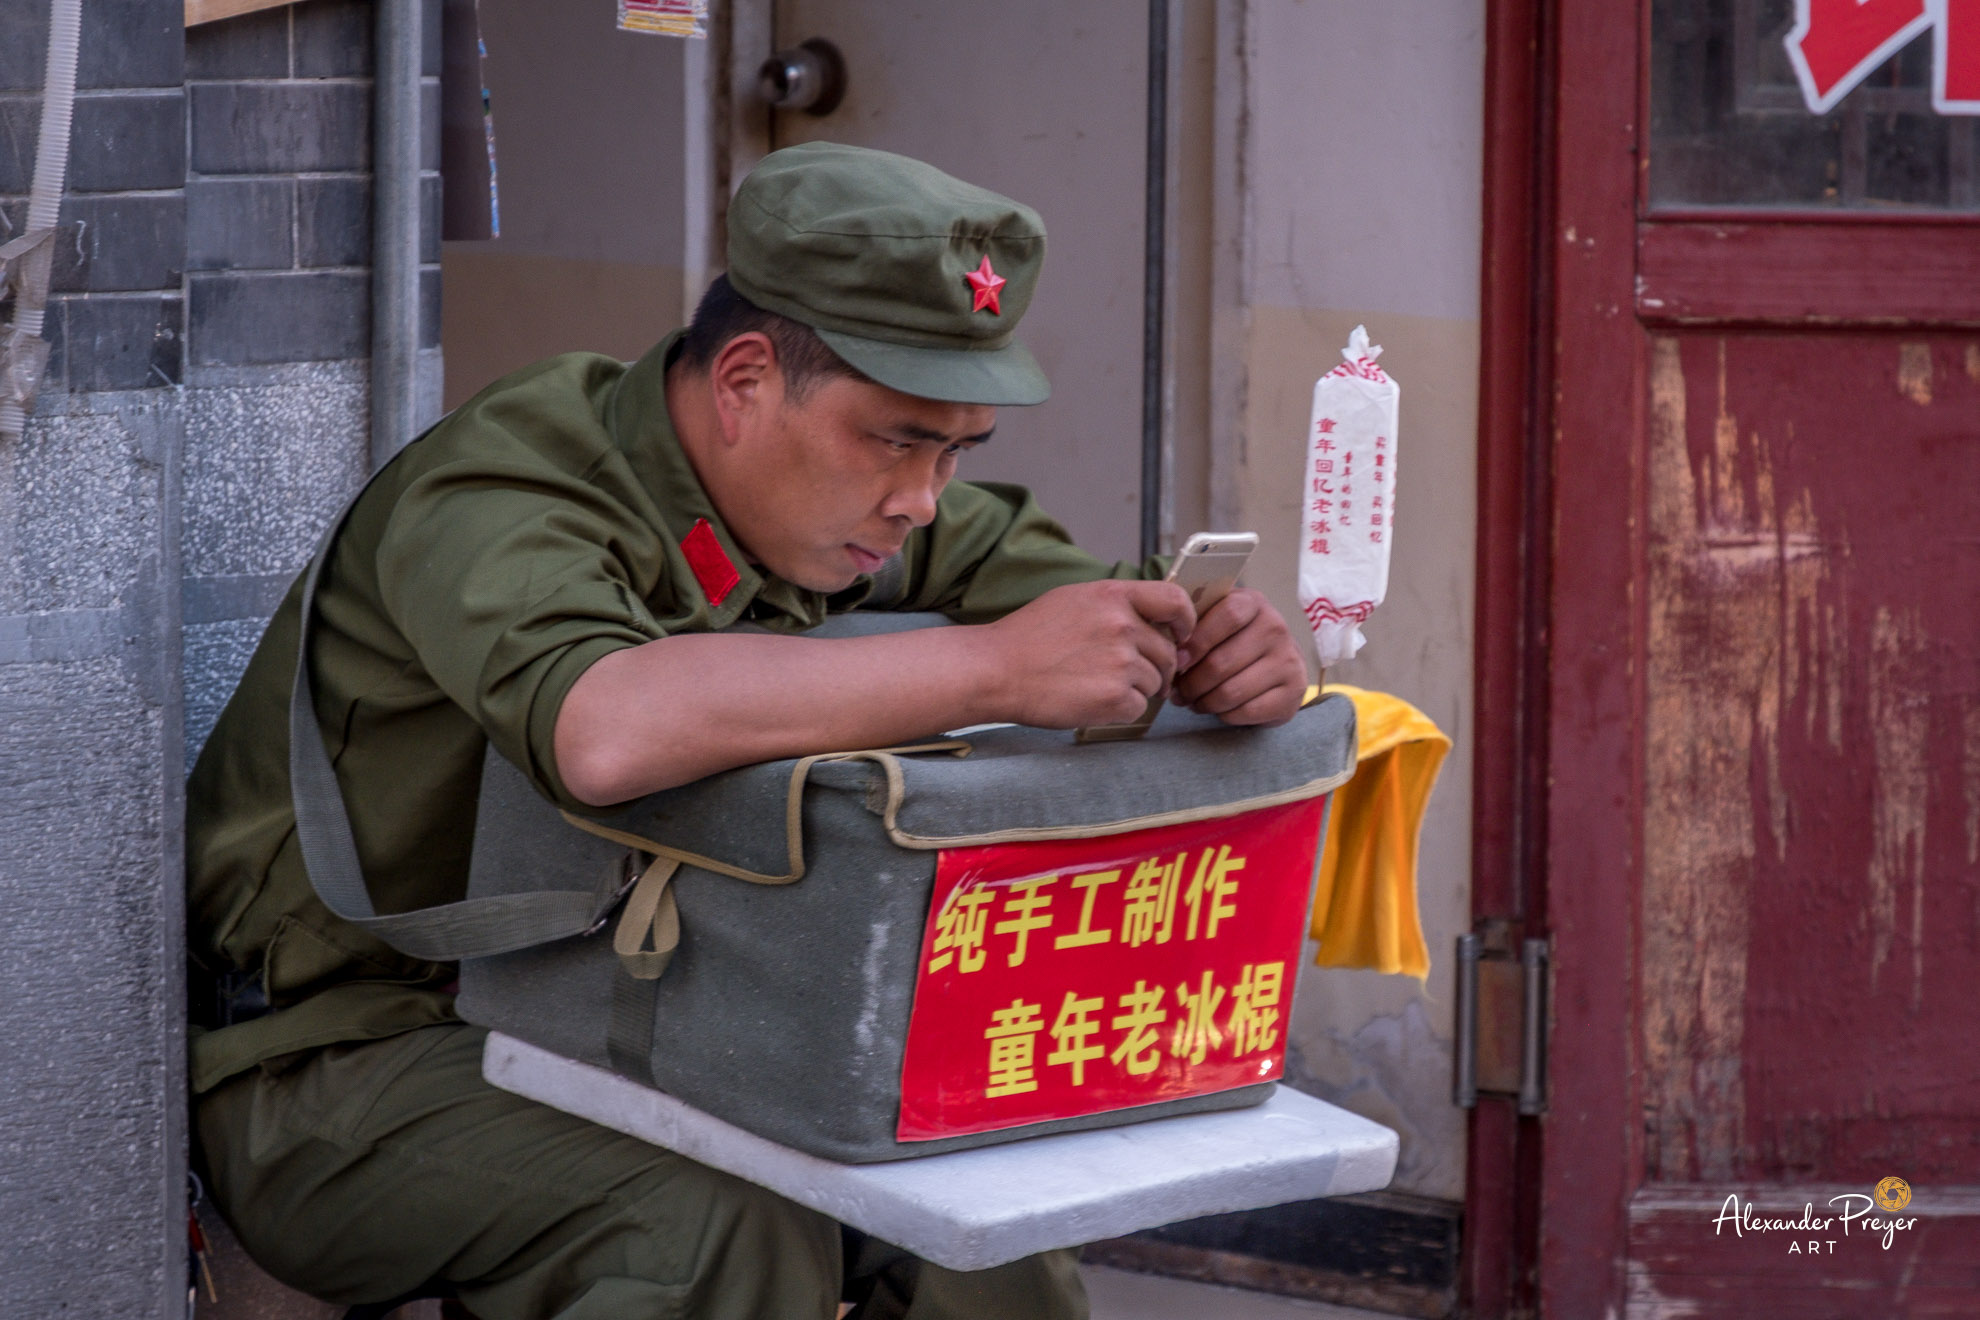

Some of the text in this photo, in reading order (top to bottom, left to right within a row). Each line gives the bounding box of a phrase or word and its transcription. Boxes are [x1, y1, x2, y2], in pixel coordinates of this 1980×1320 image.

[1309, 417, 1338, 555] 童年回忆老冰棍
[928, 844, 1246, 974] 纯手工制作
[984, 961, 1285, 1099] 童年老冰棍
